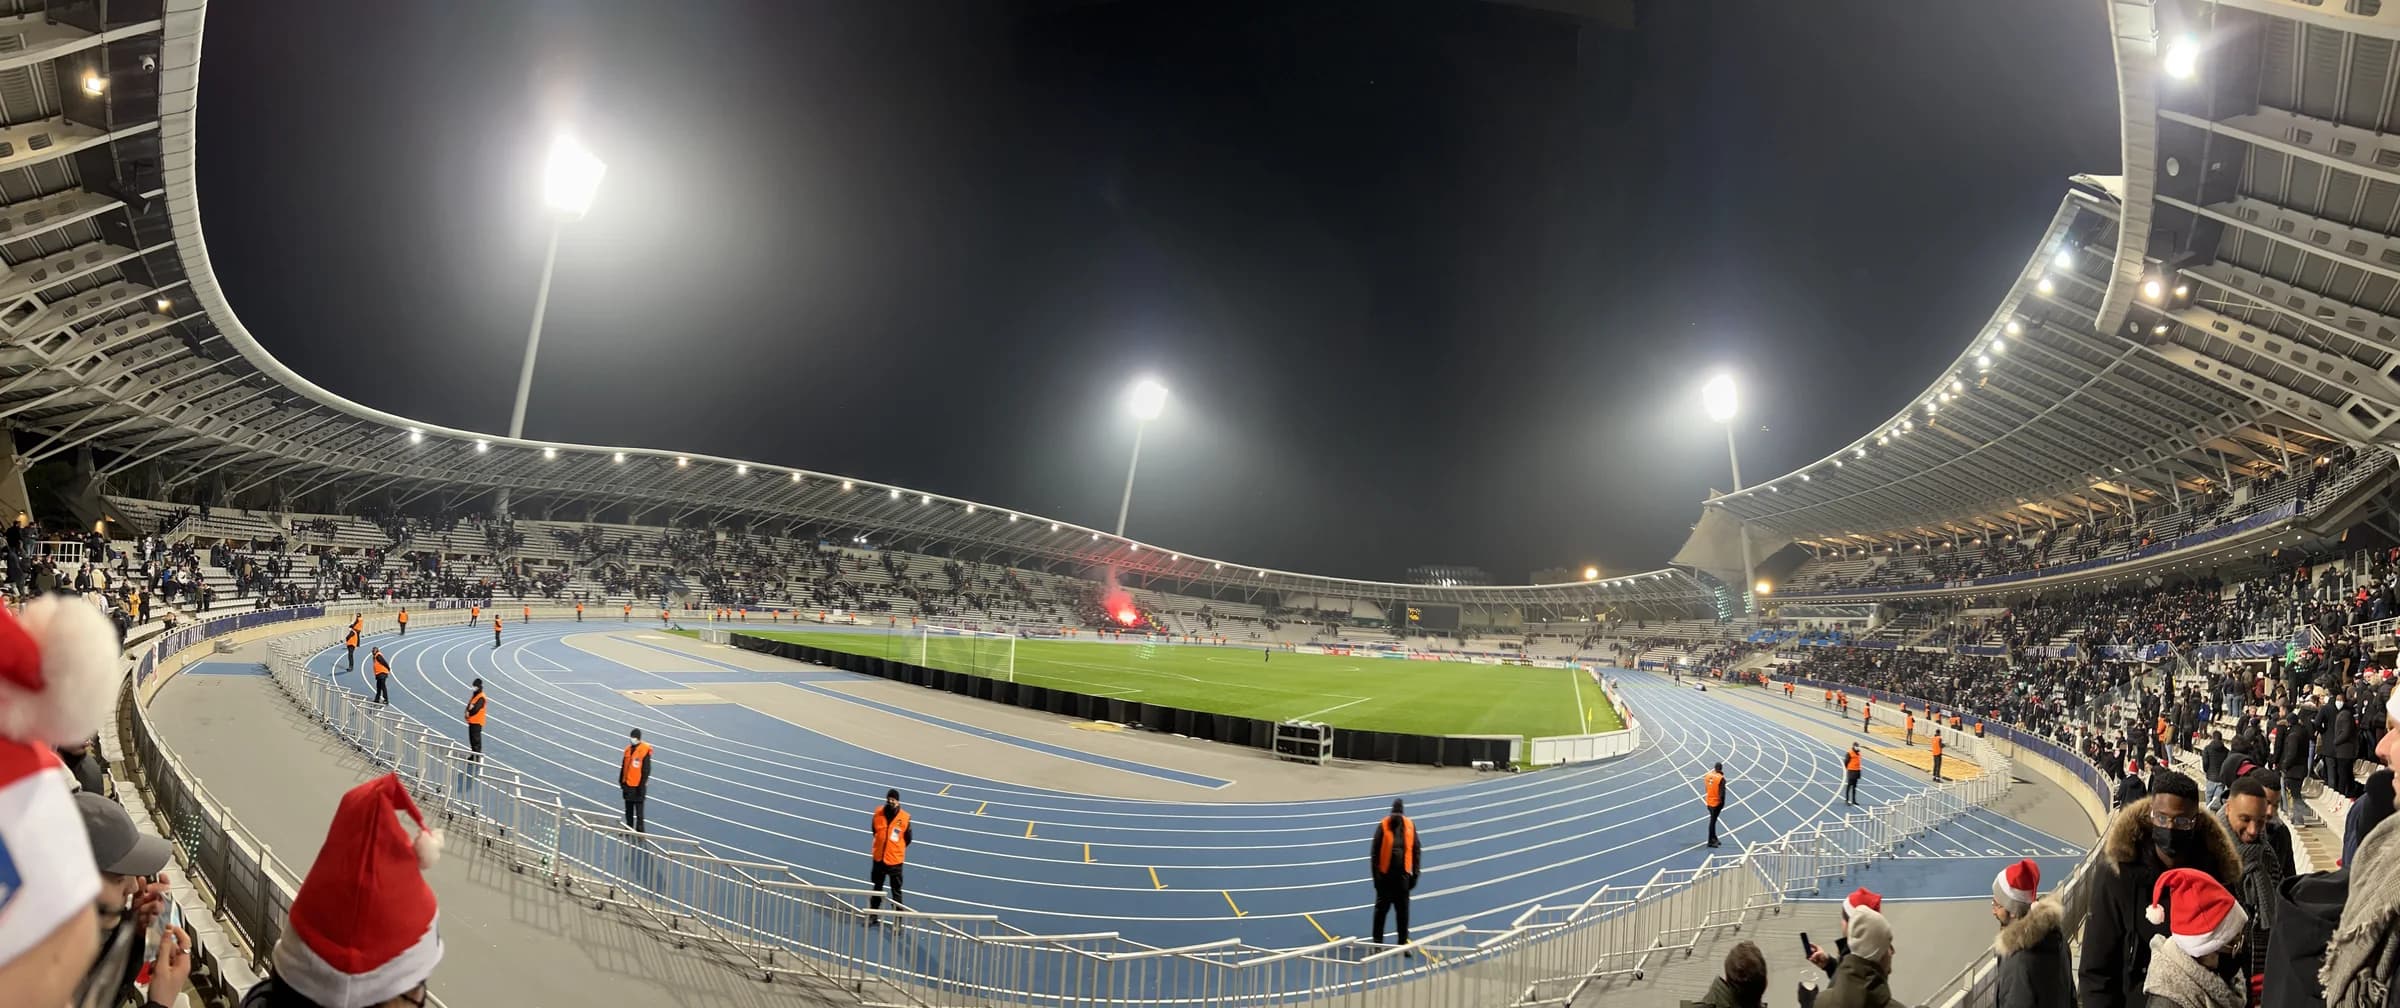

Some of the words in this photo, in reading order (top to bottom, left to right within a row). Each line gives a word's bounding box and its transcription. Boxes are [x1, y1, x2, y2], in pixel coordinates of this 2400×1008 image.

[1907, 849, 1925, 857] 4
[1944, 849, 1966, 857] 5
[1986, 848, 2005, 856] 6
[2022, 848, 2040, 856] 7
[2061, 847, 2081, 856] 8
